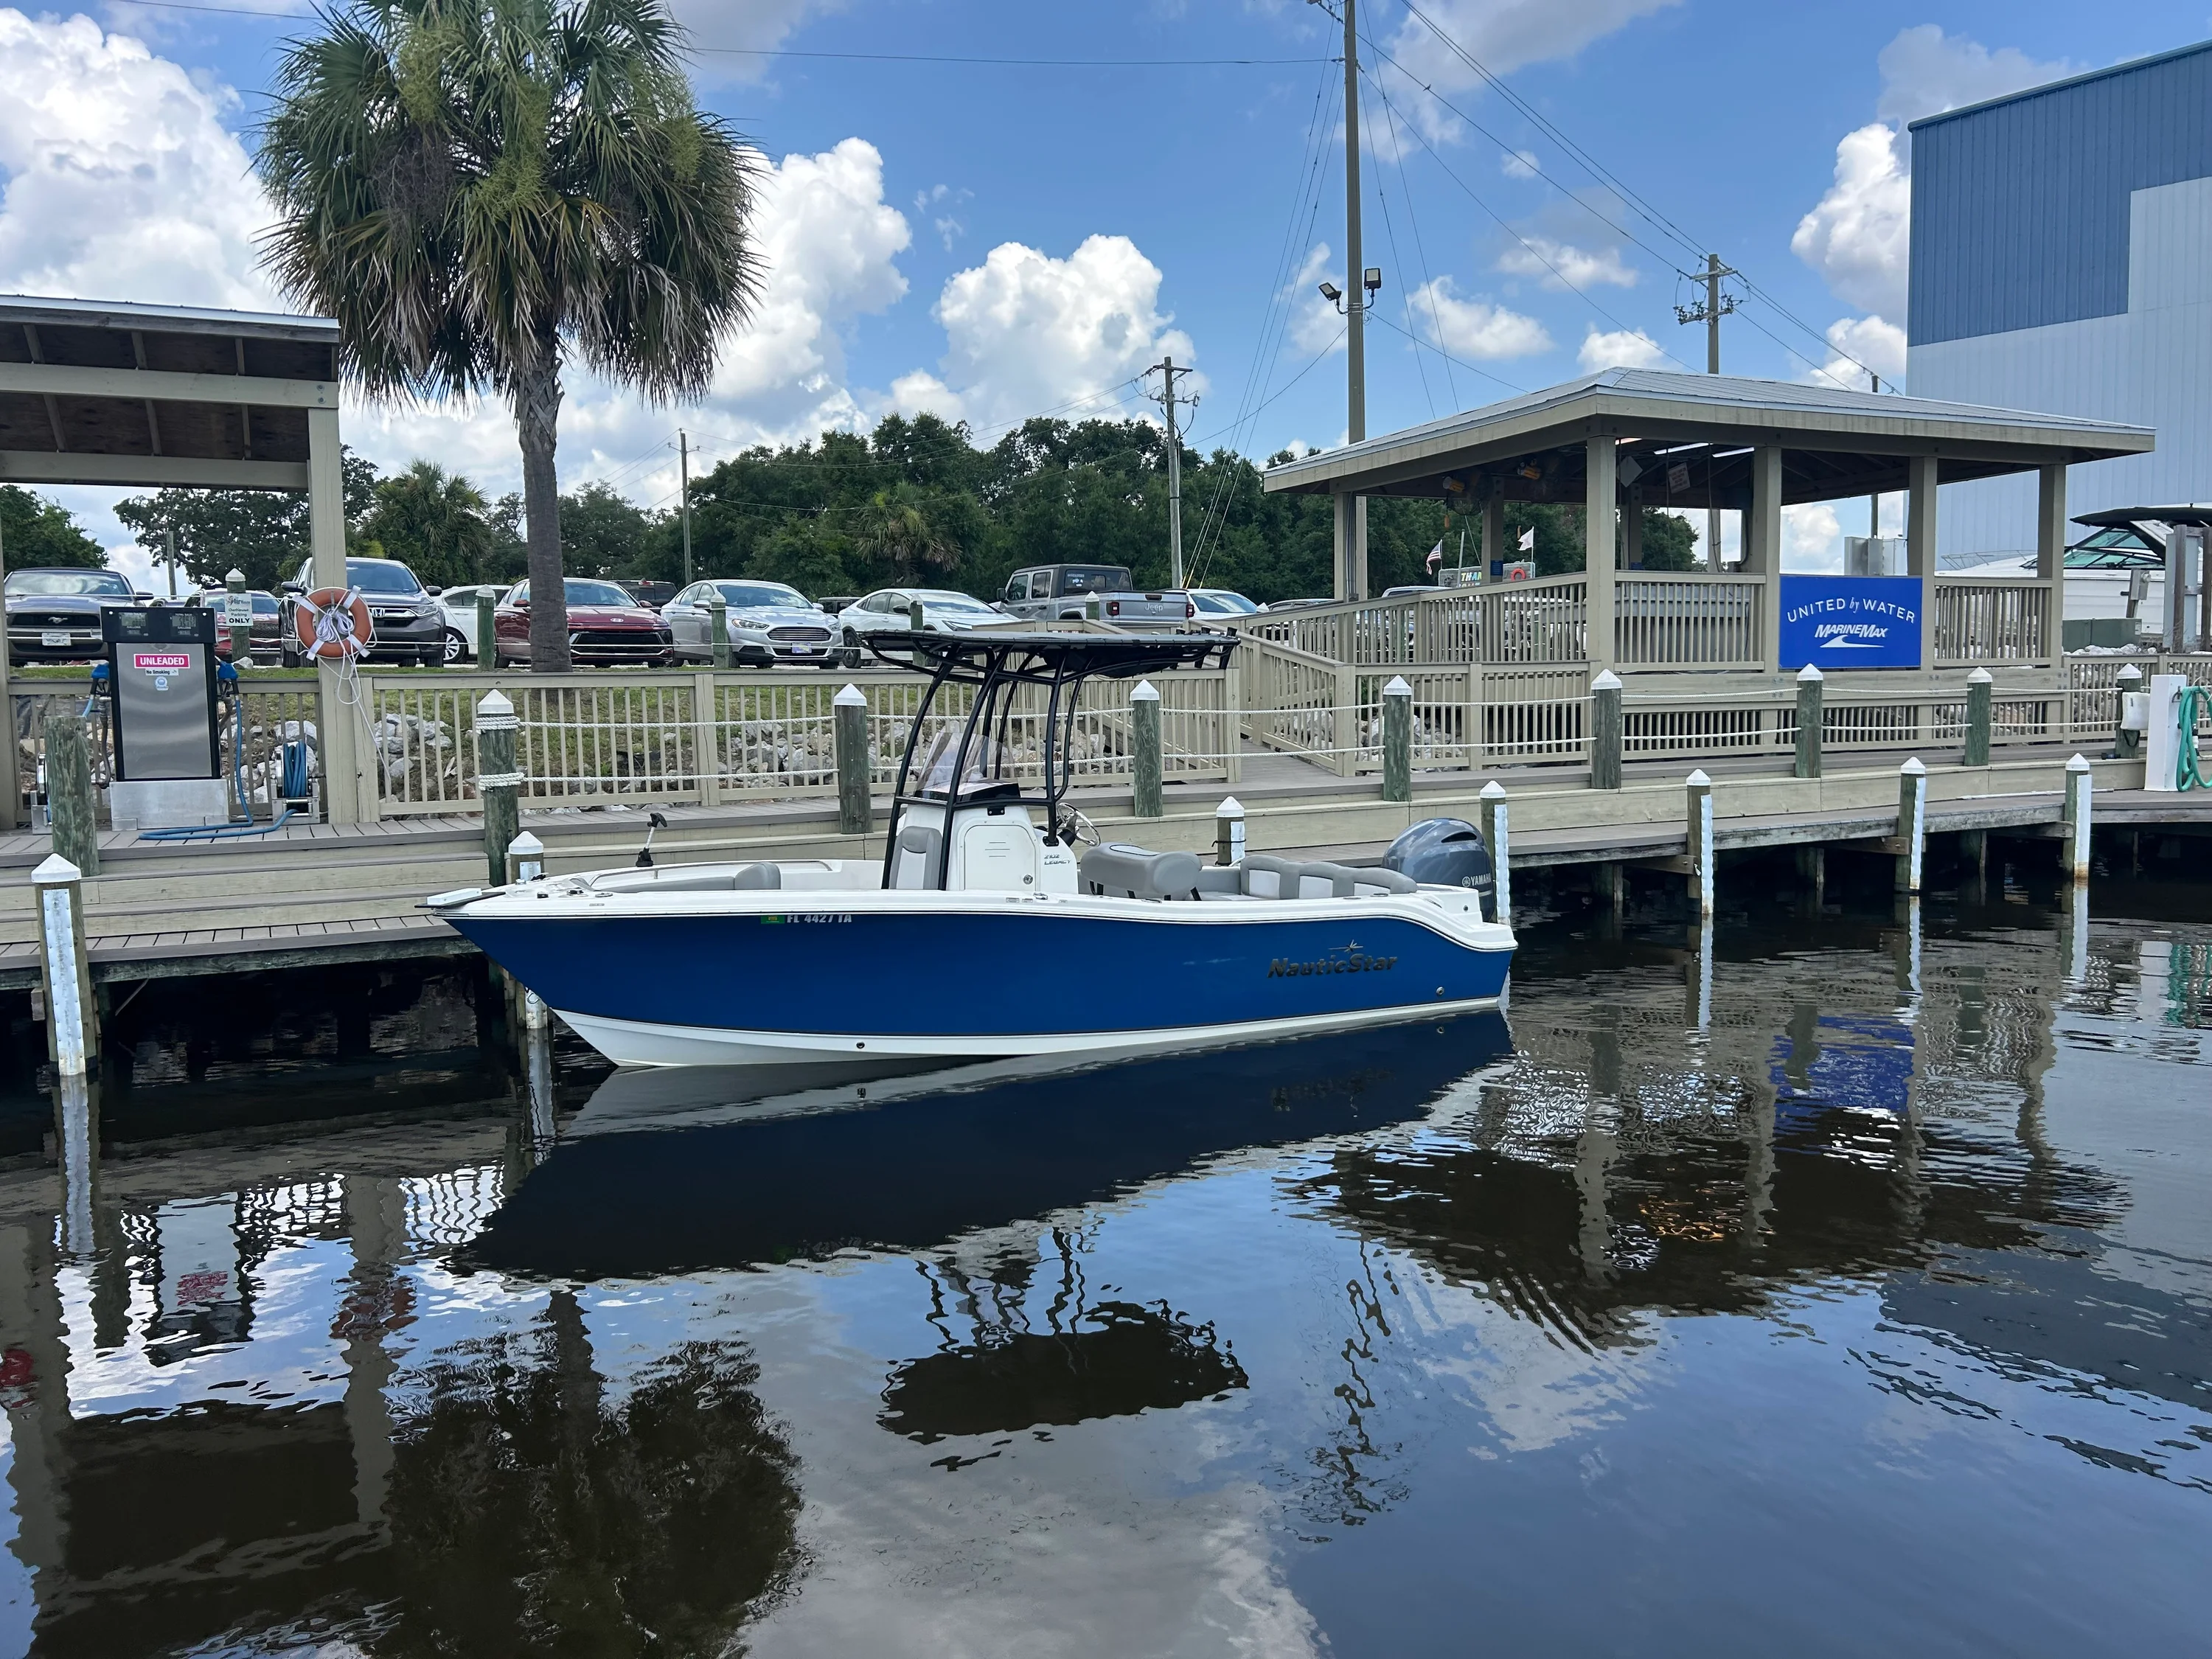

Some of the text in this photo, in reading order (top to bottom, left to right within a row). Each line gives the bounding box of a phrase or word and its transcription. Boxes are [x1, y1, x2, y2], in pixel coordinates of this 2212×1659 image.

[1144, 603, 1164, 611] Jeep
[1787, 597, 1915, 625] UNITED by WATER
[139, 657, 185, 665] UNLEADED
[787, 914, 799, 923] FL
[804, 914, 834, 923] 4427
[1267, 953, 1398, 978] NauticStar
